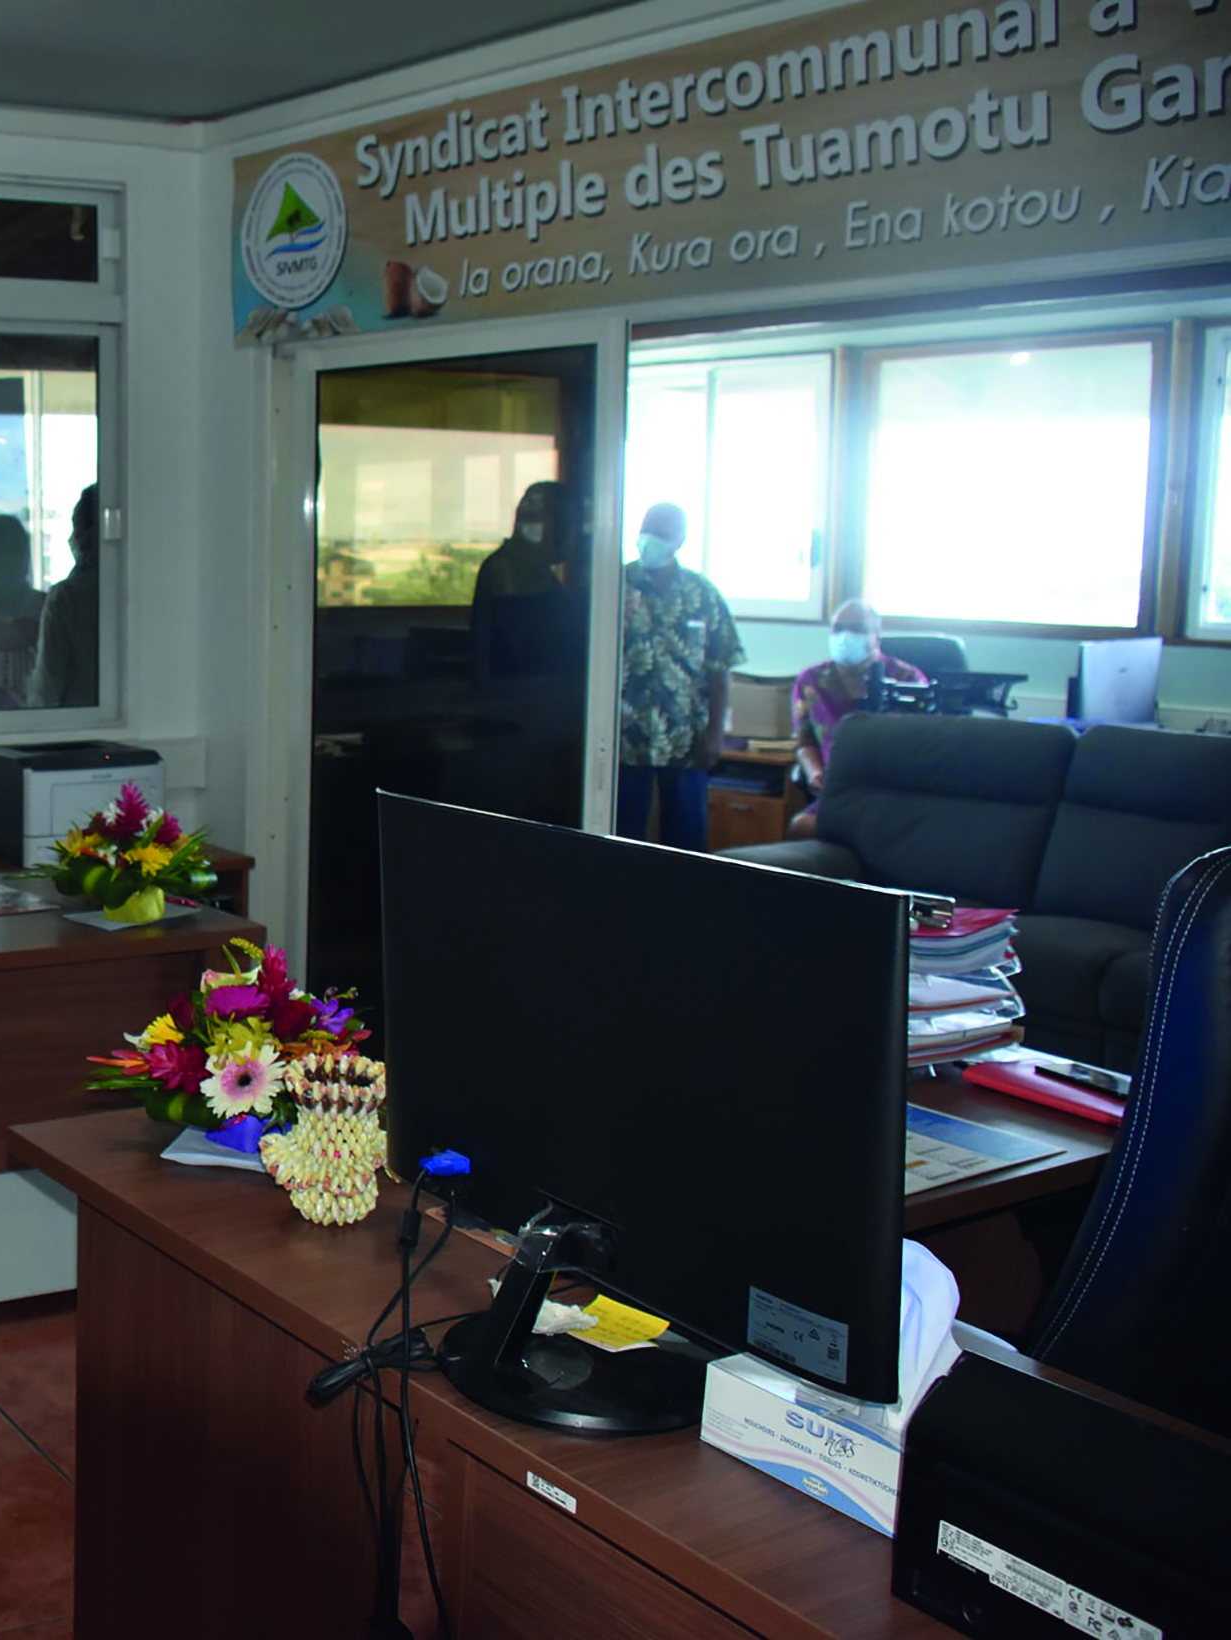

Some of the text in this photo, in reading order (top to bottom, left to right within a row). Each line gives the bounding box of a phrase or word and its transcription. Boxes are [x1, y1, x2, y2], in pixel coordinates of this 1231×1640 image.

[355, 100, 550, 198] Syndicat
[563, 0, 1059, 144] Intercommunal
[404, 161, 607, 247] Multiple
[625, 144, 726, 210] des
[741, 87, 1051, 189] Tuamotu
[501, 251, 613, 292] orana,
[628, 231, 713, 276] Kura
[844, 201, 924, 250] Ena
[943, 184, 1081, 238] kotou
[1142, 154, 1231, 213] Kia
